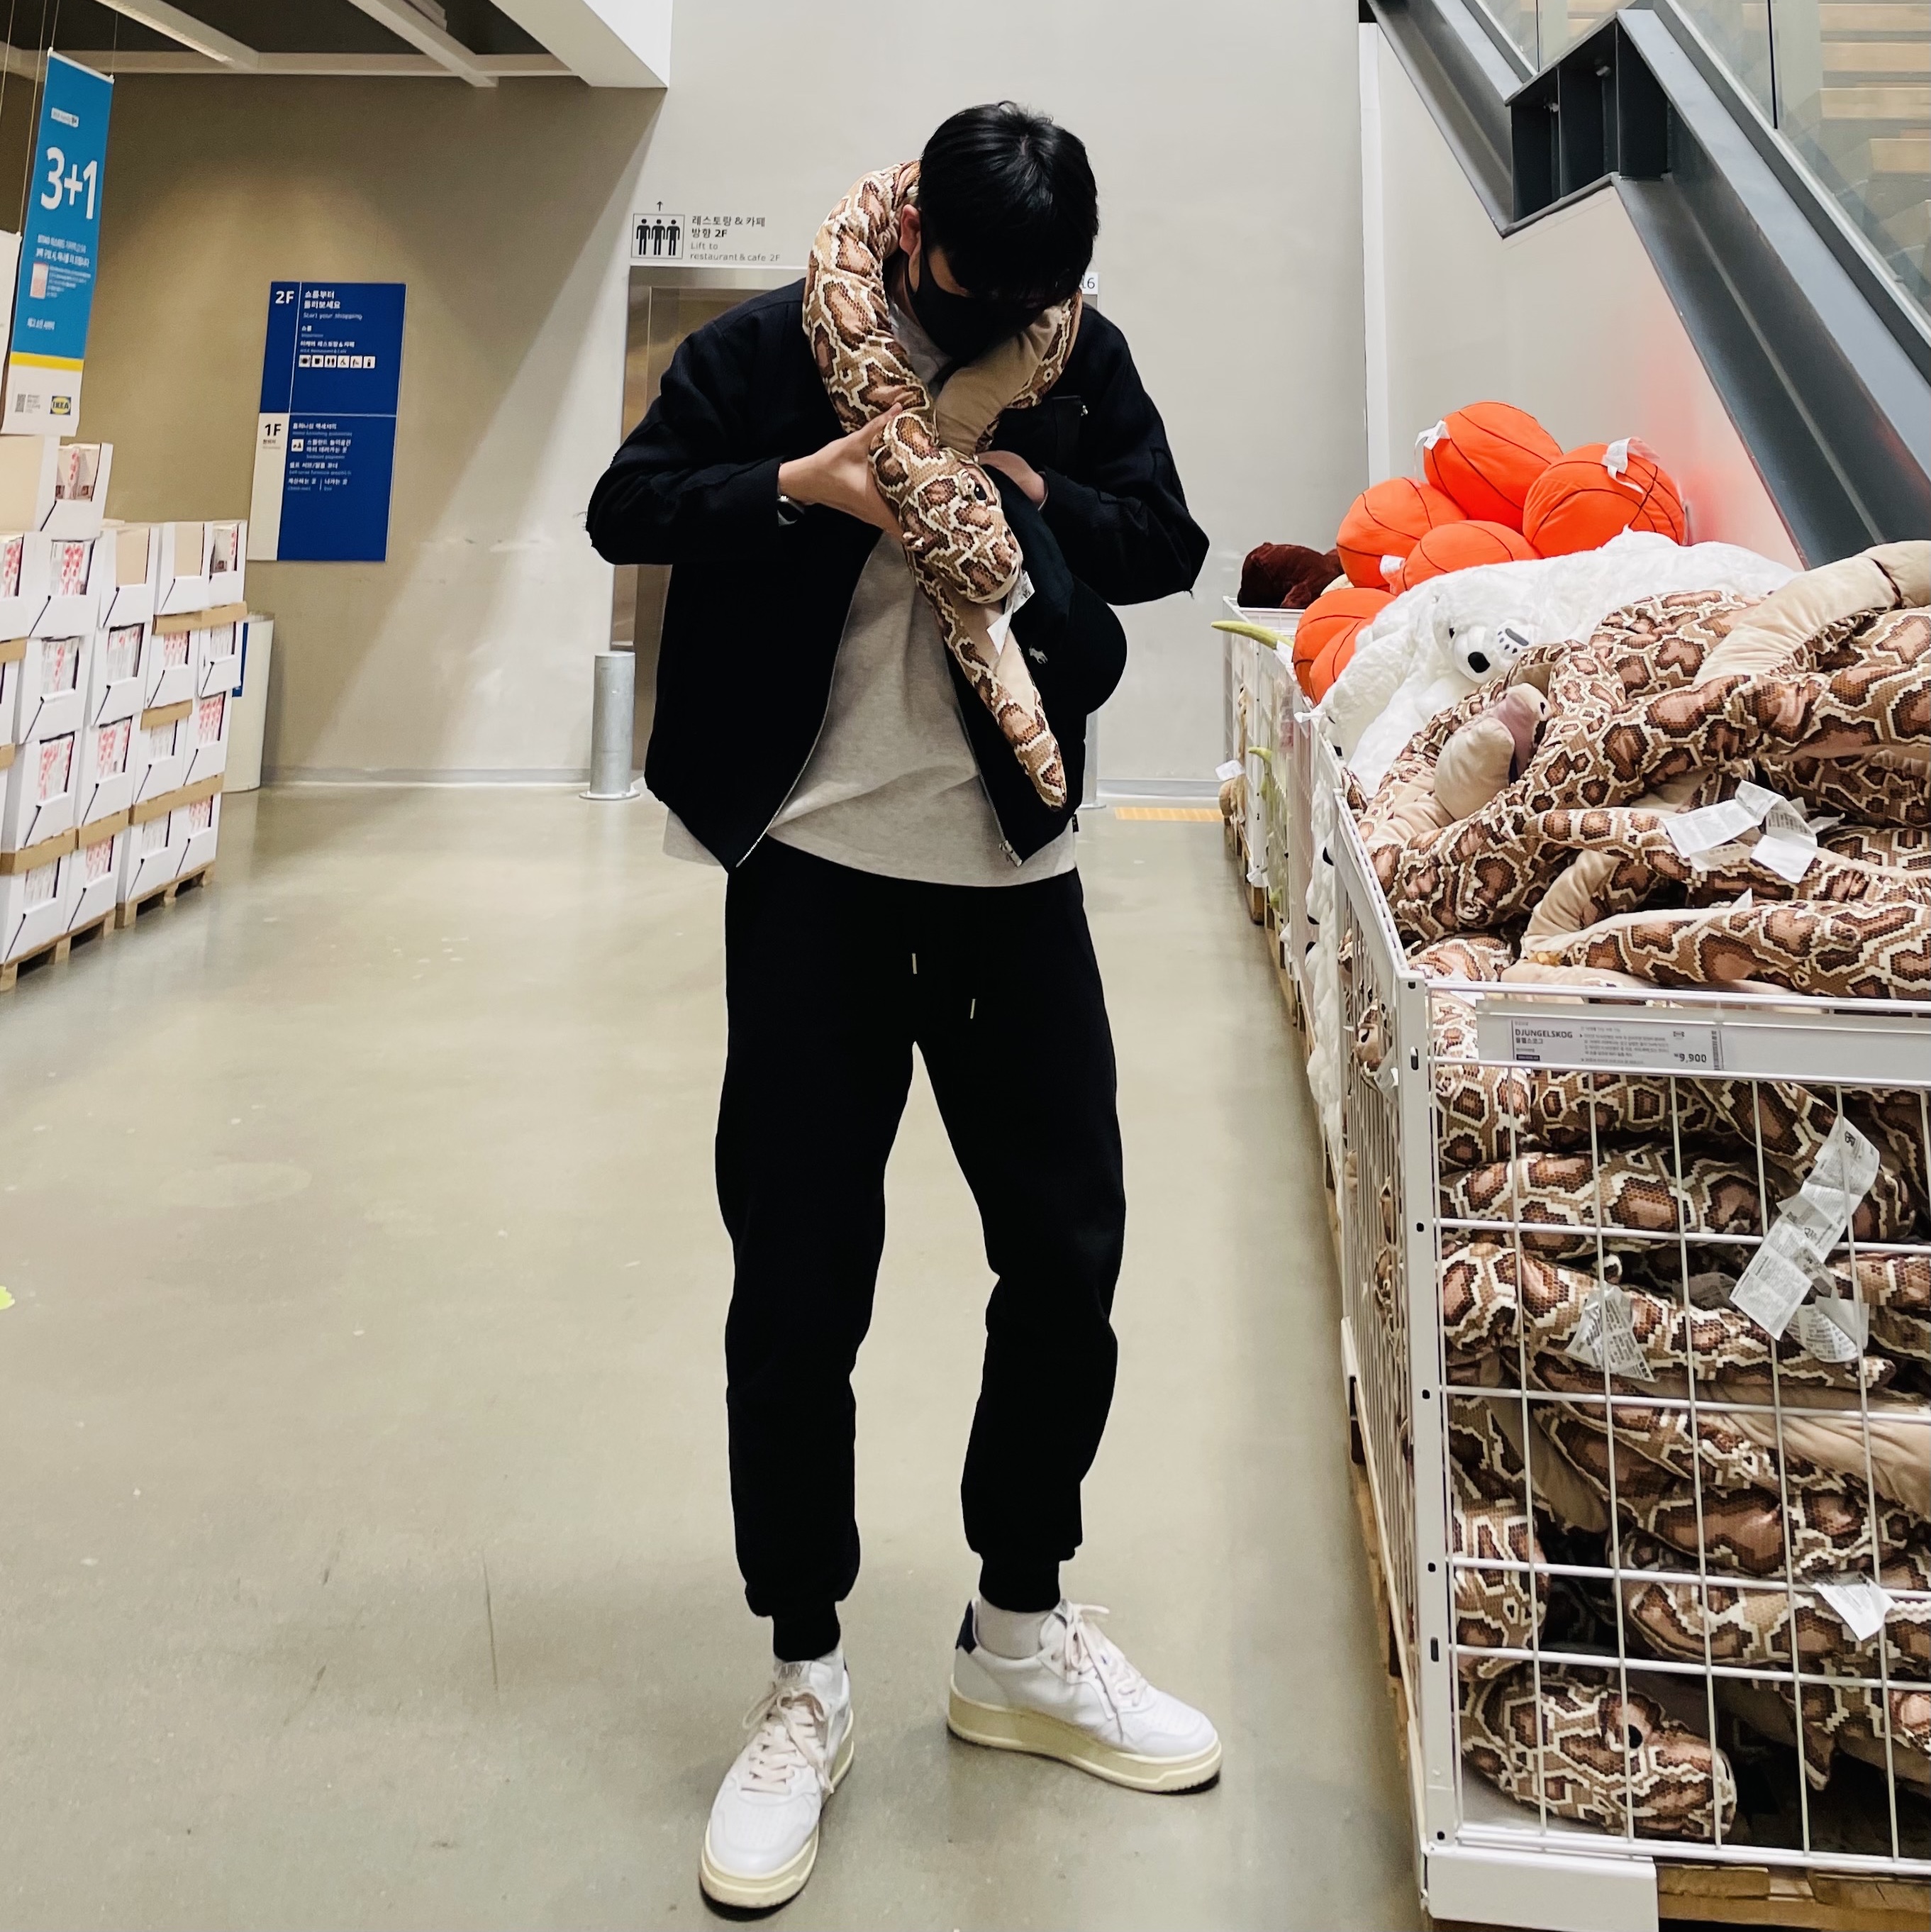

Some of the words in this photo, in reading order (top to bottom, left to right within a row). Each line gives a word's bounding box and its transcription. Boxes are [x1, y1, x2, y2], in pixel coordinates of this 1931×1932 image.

[40, 146, 98, 220] 3+1
[692, 216, 731, 226] 레스토랑
[735, 216, 743, 226] &
[746, 216, 766, 228] 카페
[691, 228, 711, 238] 방향
[715, 228, 728, 238] 2F
[691, 241, 706, 250] Lift
[747, 253, 767, 262] cafe
[275, 290, 295, 304] 2F
[265, 423, 282, 436] 1F
[1515, 1028, 1574, 1039] DJUNGELSKOG
